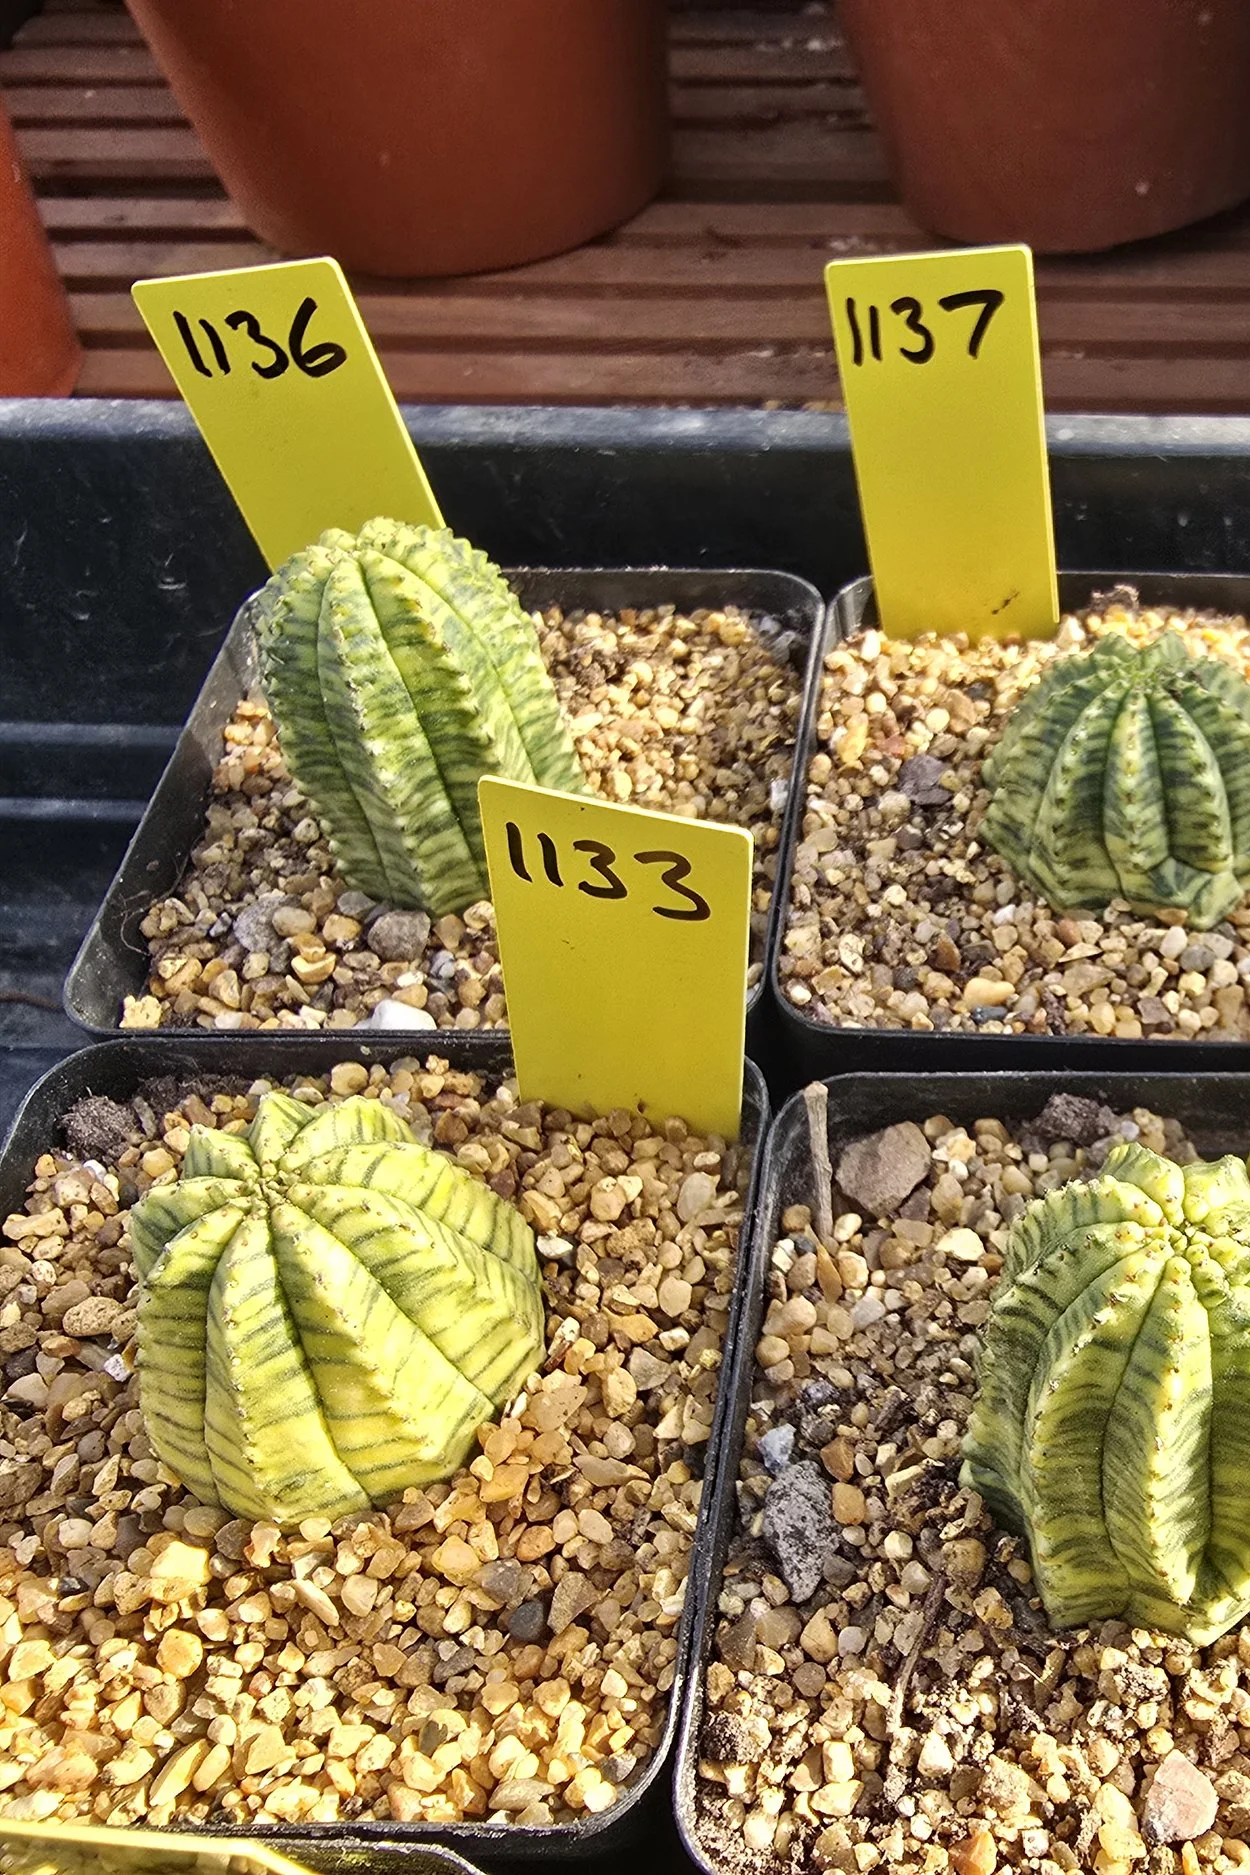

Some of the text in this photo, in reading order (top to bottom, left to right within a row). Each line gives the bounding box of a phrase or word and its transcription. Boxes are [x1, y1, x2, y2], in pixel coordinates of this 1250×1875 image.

[172, 296, 347, 380] 1136
[846, 289, 1005, 367] 1137
[505, 821, 711, 921] 1133
